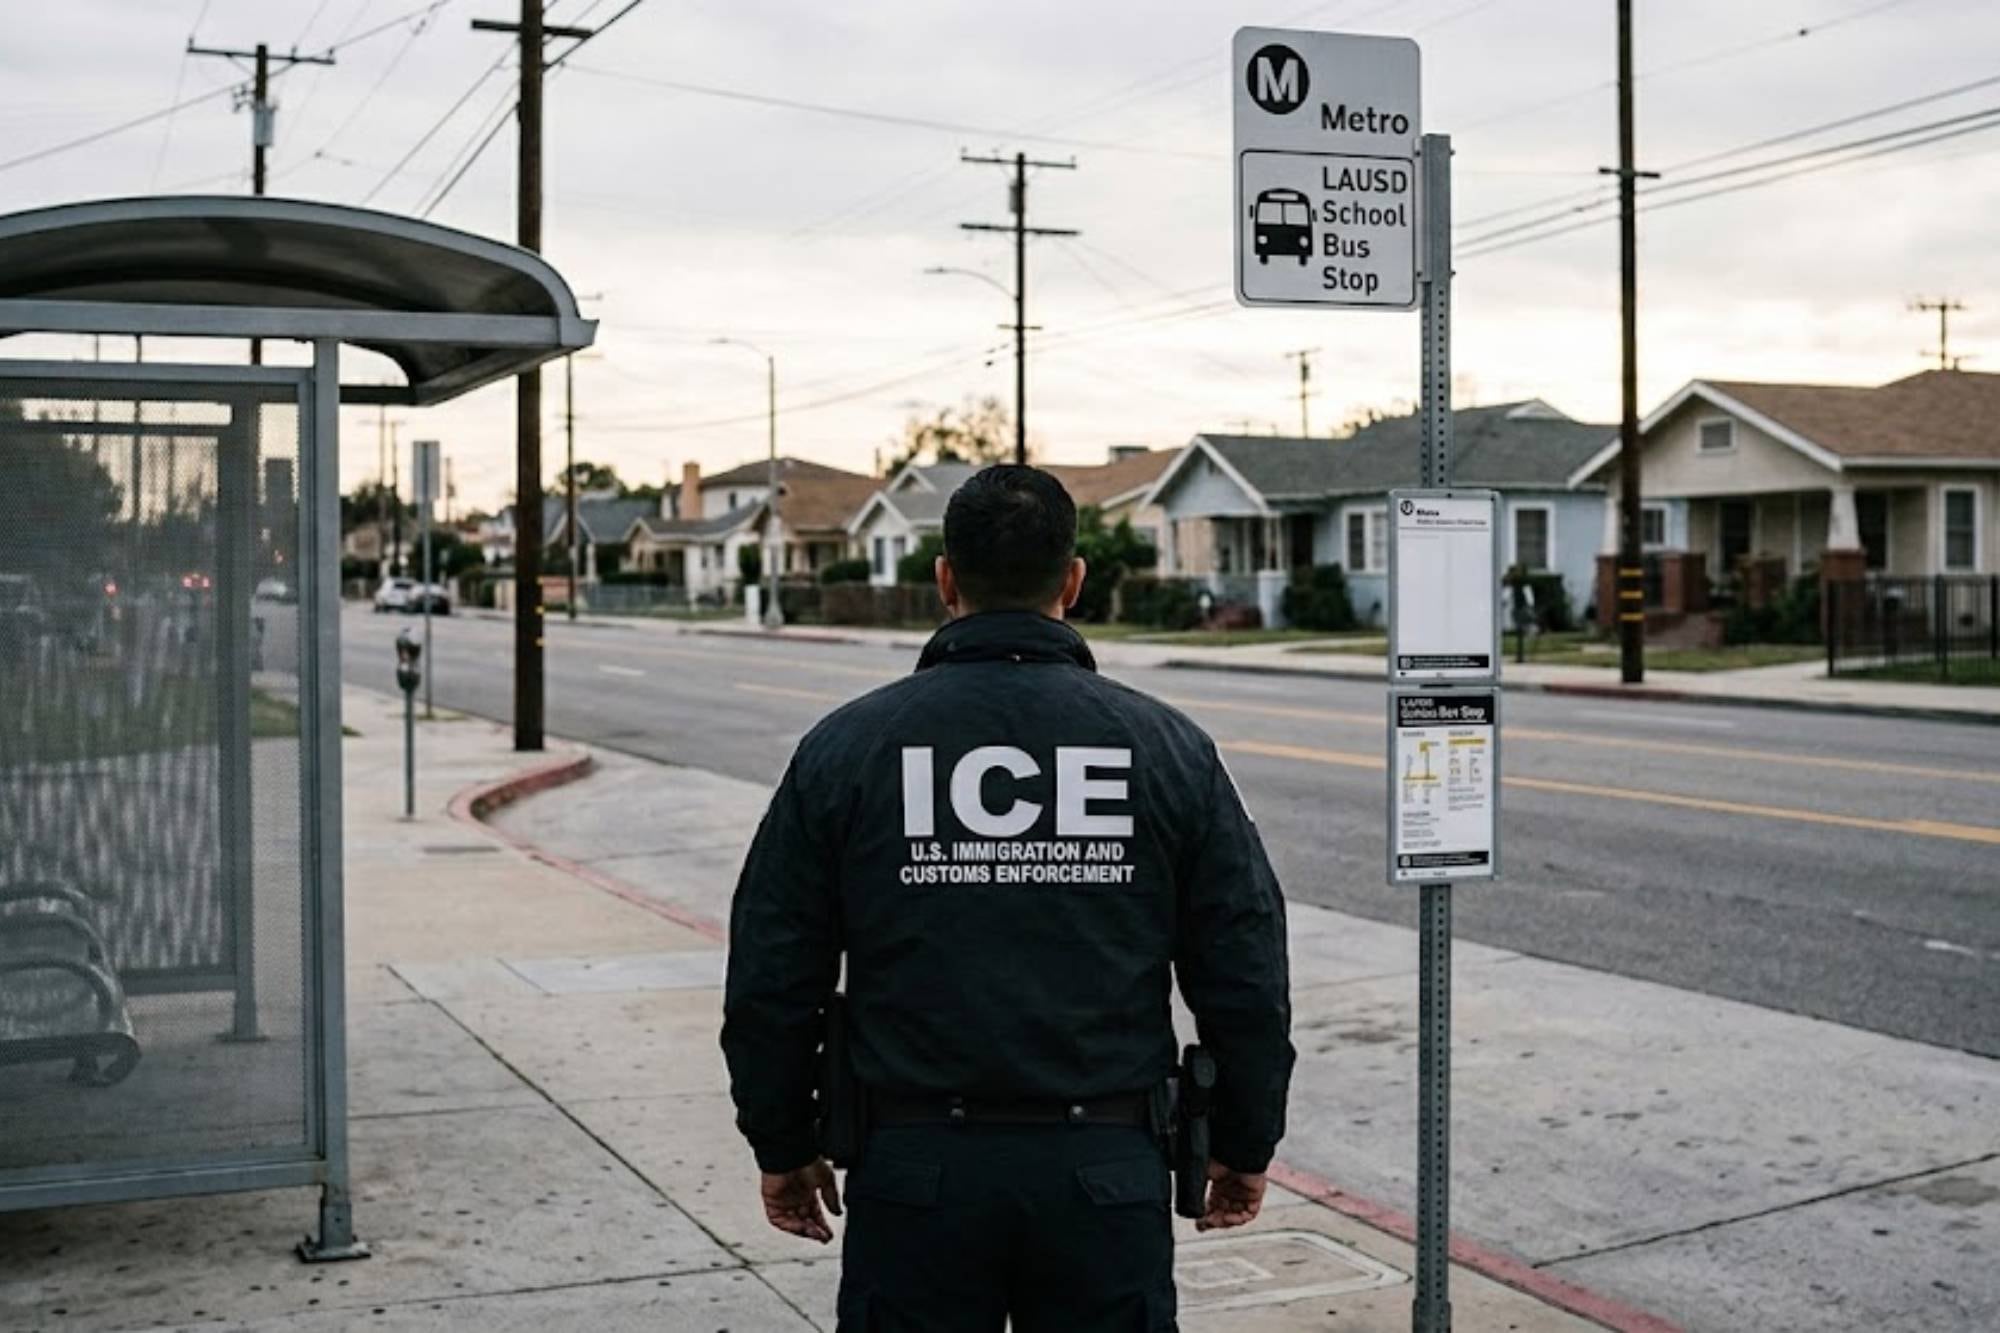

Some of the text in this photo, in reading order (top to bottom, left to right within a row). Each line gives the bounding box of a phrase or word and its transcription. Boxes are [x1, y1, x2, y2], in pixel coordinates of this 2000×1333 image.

[1256, 56, 1299, 103] M
[1320, 102, 1409, 135] Metro
[1322, 165, 1408, 195] LAUSD
[1322, 199, 1407, 228] School
[1323, 232, 1371, 259] Bus
[1322, 265, 1379, 296] Stop
[901, 745, 1134, 838] ICE
[911, 842, 1125, 862] U.S. IMMIGRATION AND
[900, 864, 1135, 885] CUSTOMS ENFORCEMENT
